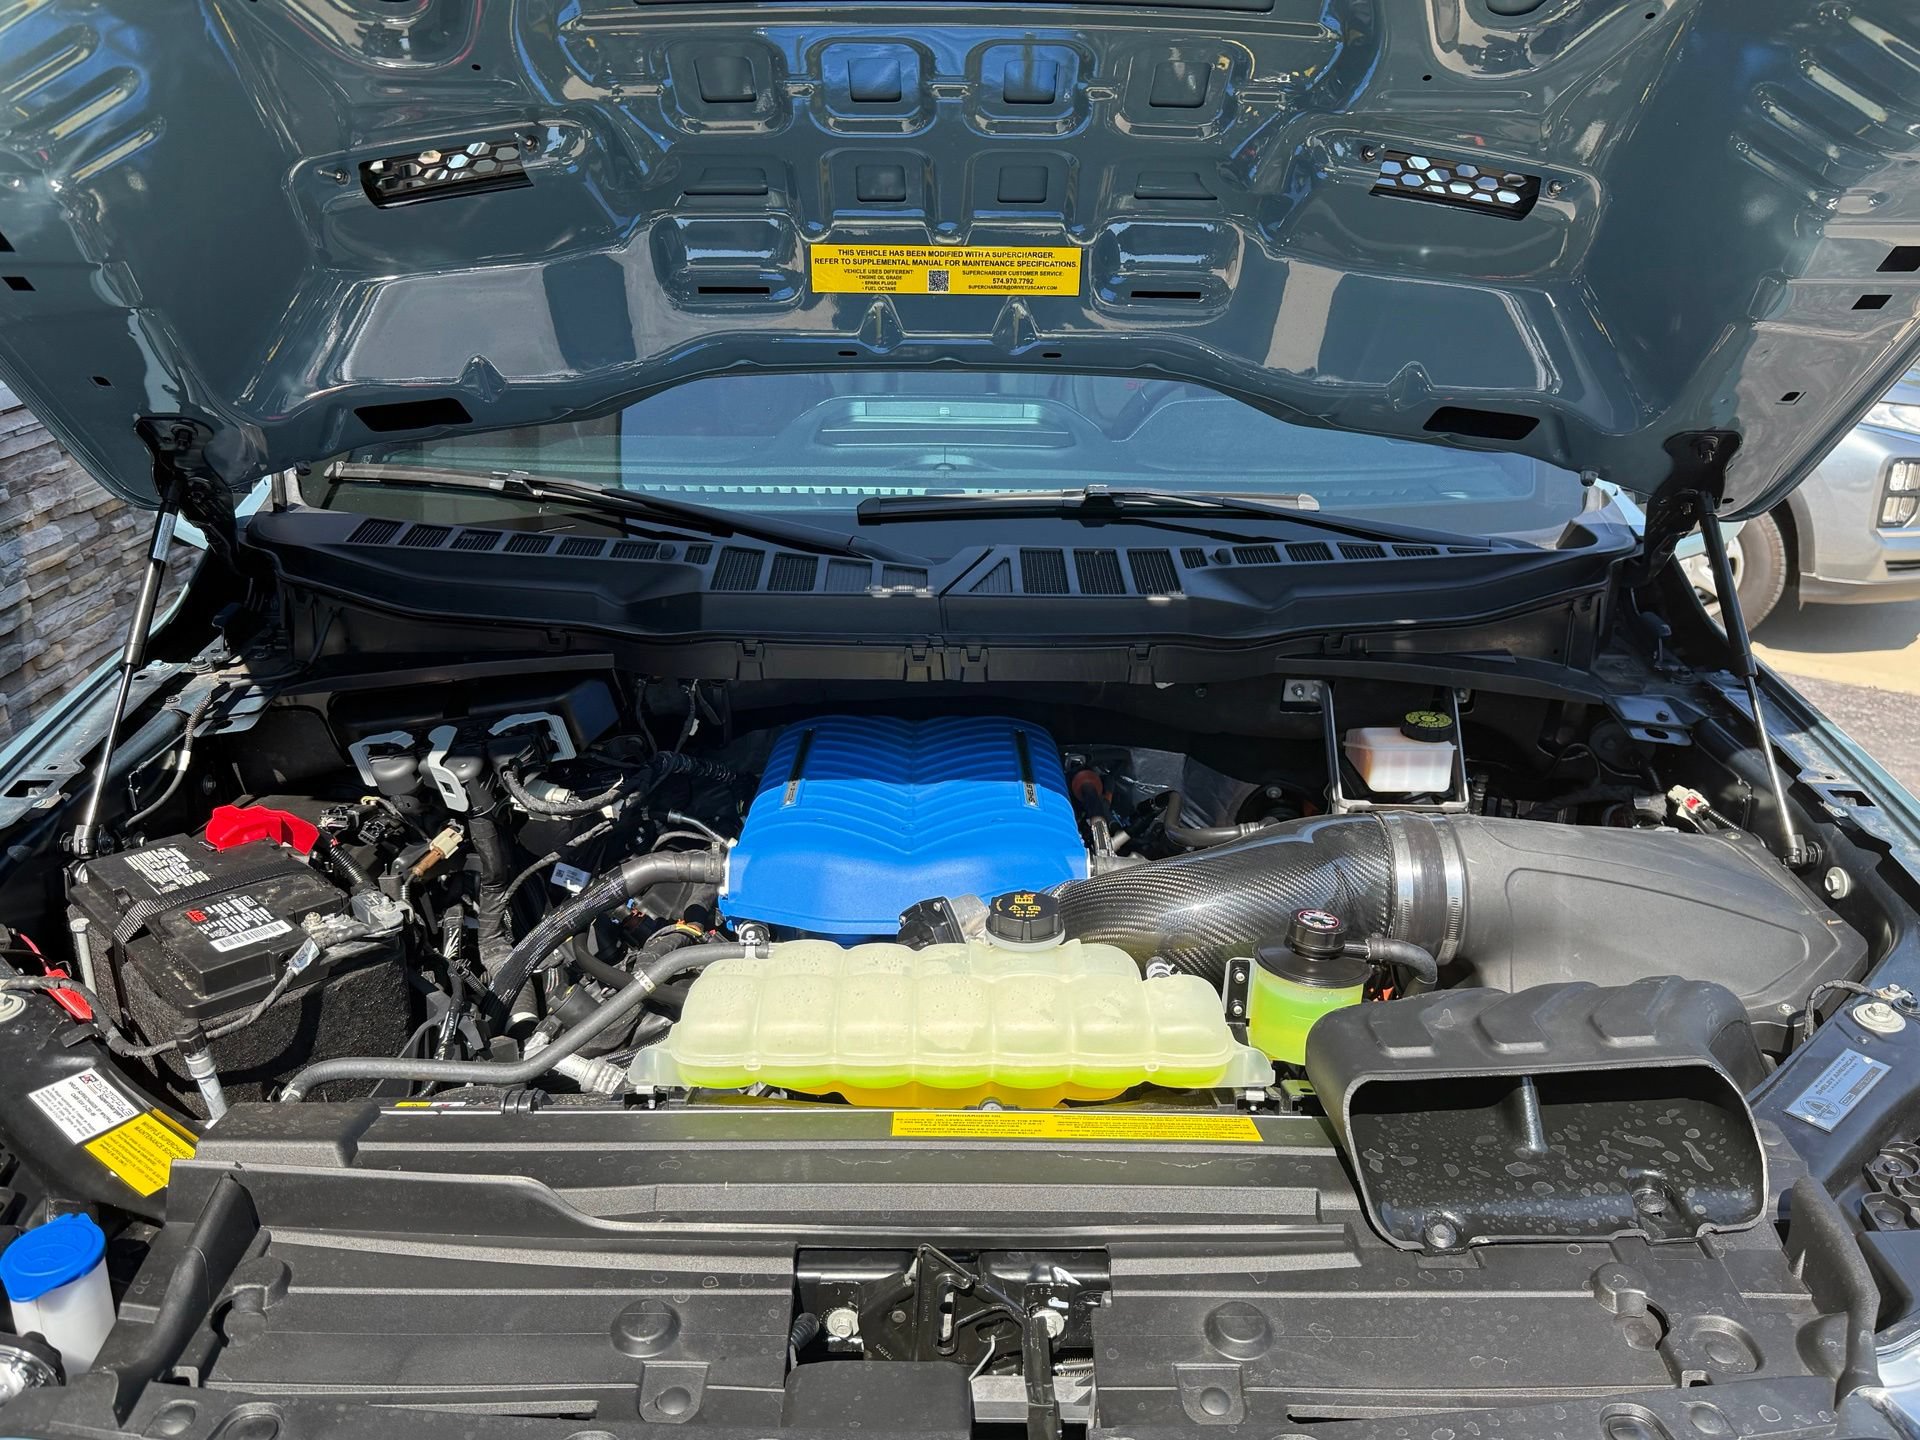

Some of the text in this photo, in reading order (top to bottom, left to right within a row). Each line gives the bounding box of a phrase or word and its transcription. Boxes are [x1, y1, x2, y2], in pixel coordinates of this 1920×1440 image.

[856, 249, 887, 257] VEHICLE
[889, 249, 905, 257] HAS
[927, 250, 964, 258] MODIFIED
[991, 251, 1055, 259] SUPERCHARGER.
[814, 257, 839, 265] REFER
[852, 258, 910, 266] SUPPLEMENTAL
[911, 258, 942, 266] MANUAL
[1016, 260, 1078, 268] SPECIFICATIONS.
[1833, 1055, 1858, 1078] AMERICAN
